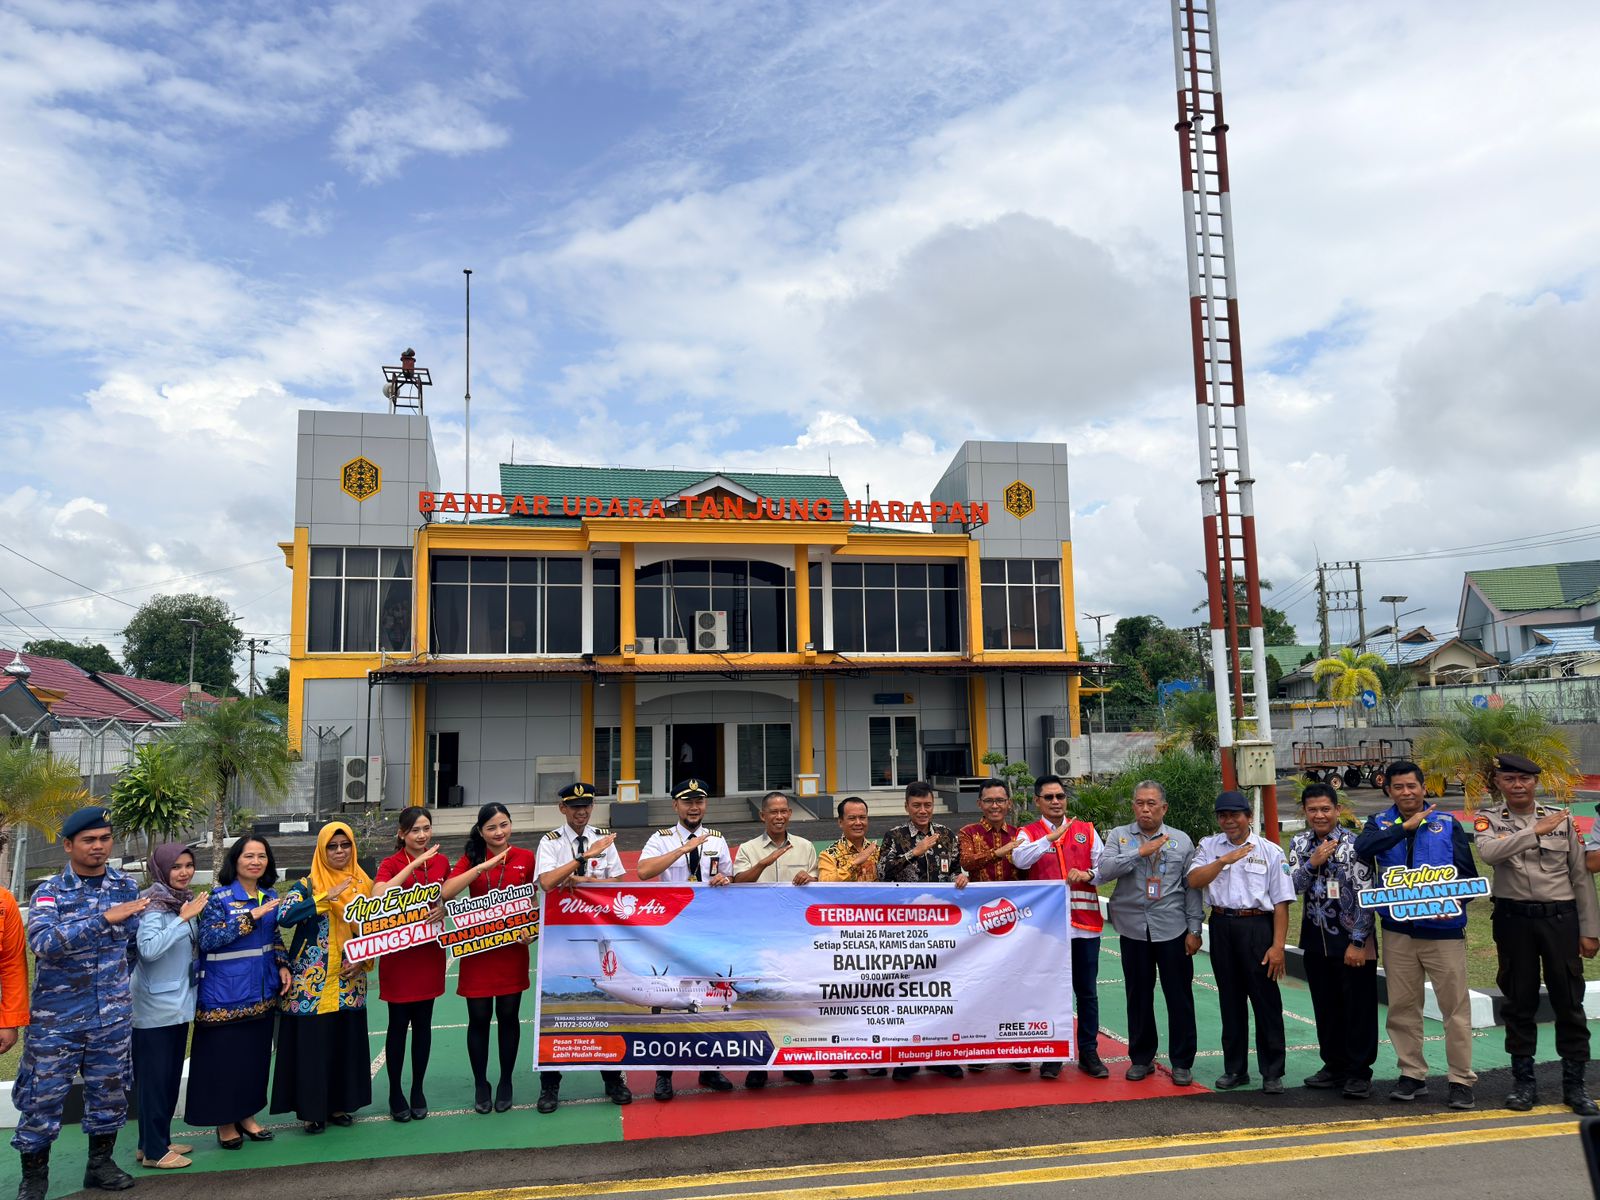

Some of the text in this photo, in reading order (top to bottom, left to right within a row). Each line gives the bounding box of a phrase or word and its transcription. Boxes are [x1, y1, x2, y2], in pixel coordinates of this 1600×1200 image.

[419, 491, 989, 524] BANDAR UDARA TANJUNG HARAPAN
[1386, 866, 1455, 888] Explore
[448, 885, 532, 914] Terbang Perdana
[1360, 879, 1487, 905] KALIMANTAN
[346, 884, 441, 920] Ayo Explore
[559, 897, 666, 918] Wings Air
[1393, 899, 1459, 918] UTARA
[362, 908, 428, 935] BERSAMA
[455, 899, 530, 928] WINGS AIR
[818, 908, 949, 922] TERBANG KEMBALI
[968, 906, 1032, 936] LANGSUNG
[983, 906, 1012, 918] TERBANG
[440, 910, 539, 946] TANJUNG SELO
[840, 929, 928, 939] Mulai 26 Maret 2026
[349, 920, 443, 960] WINGS AIR
[813, 940, 956, 951] Setiap SELASA, KAMIS dan SABTU
[833, 954, 937, 971] BALIKPAPAN
[819, 981, 952, 1000] TANJUNG SELOR
[818, 1006, 859, 1015] TANJUNG
[861, 1006, 889, 1015] SELOR
[897, 1005, 954, 1015] BALIKPAPAN
[999, 1022, 1048, 1031] FREE 7KG
[633, 1040, 764, 1057] BOOKCABIN
[783, 1050, 883, 1061] www.lionair.co.id
[898, 1045, 1054, 1060] Hubungi Biro Perjalanan terdekat Anda
